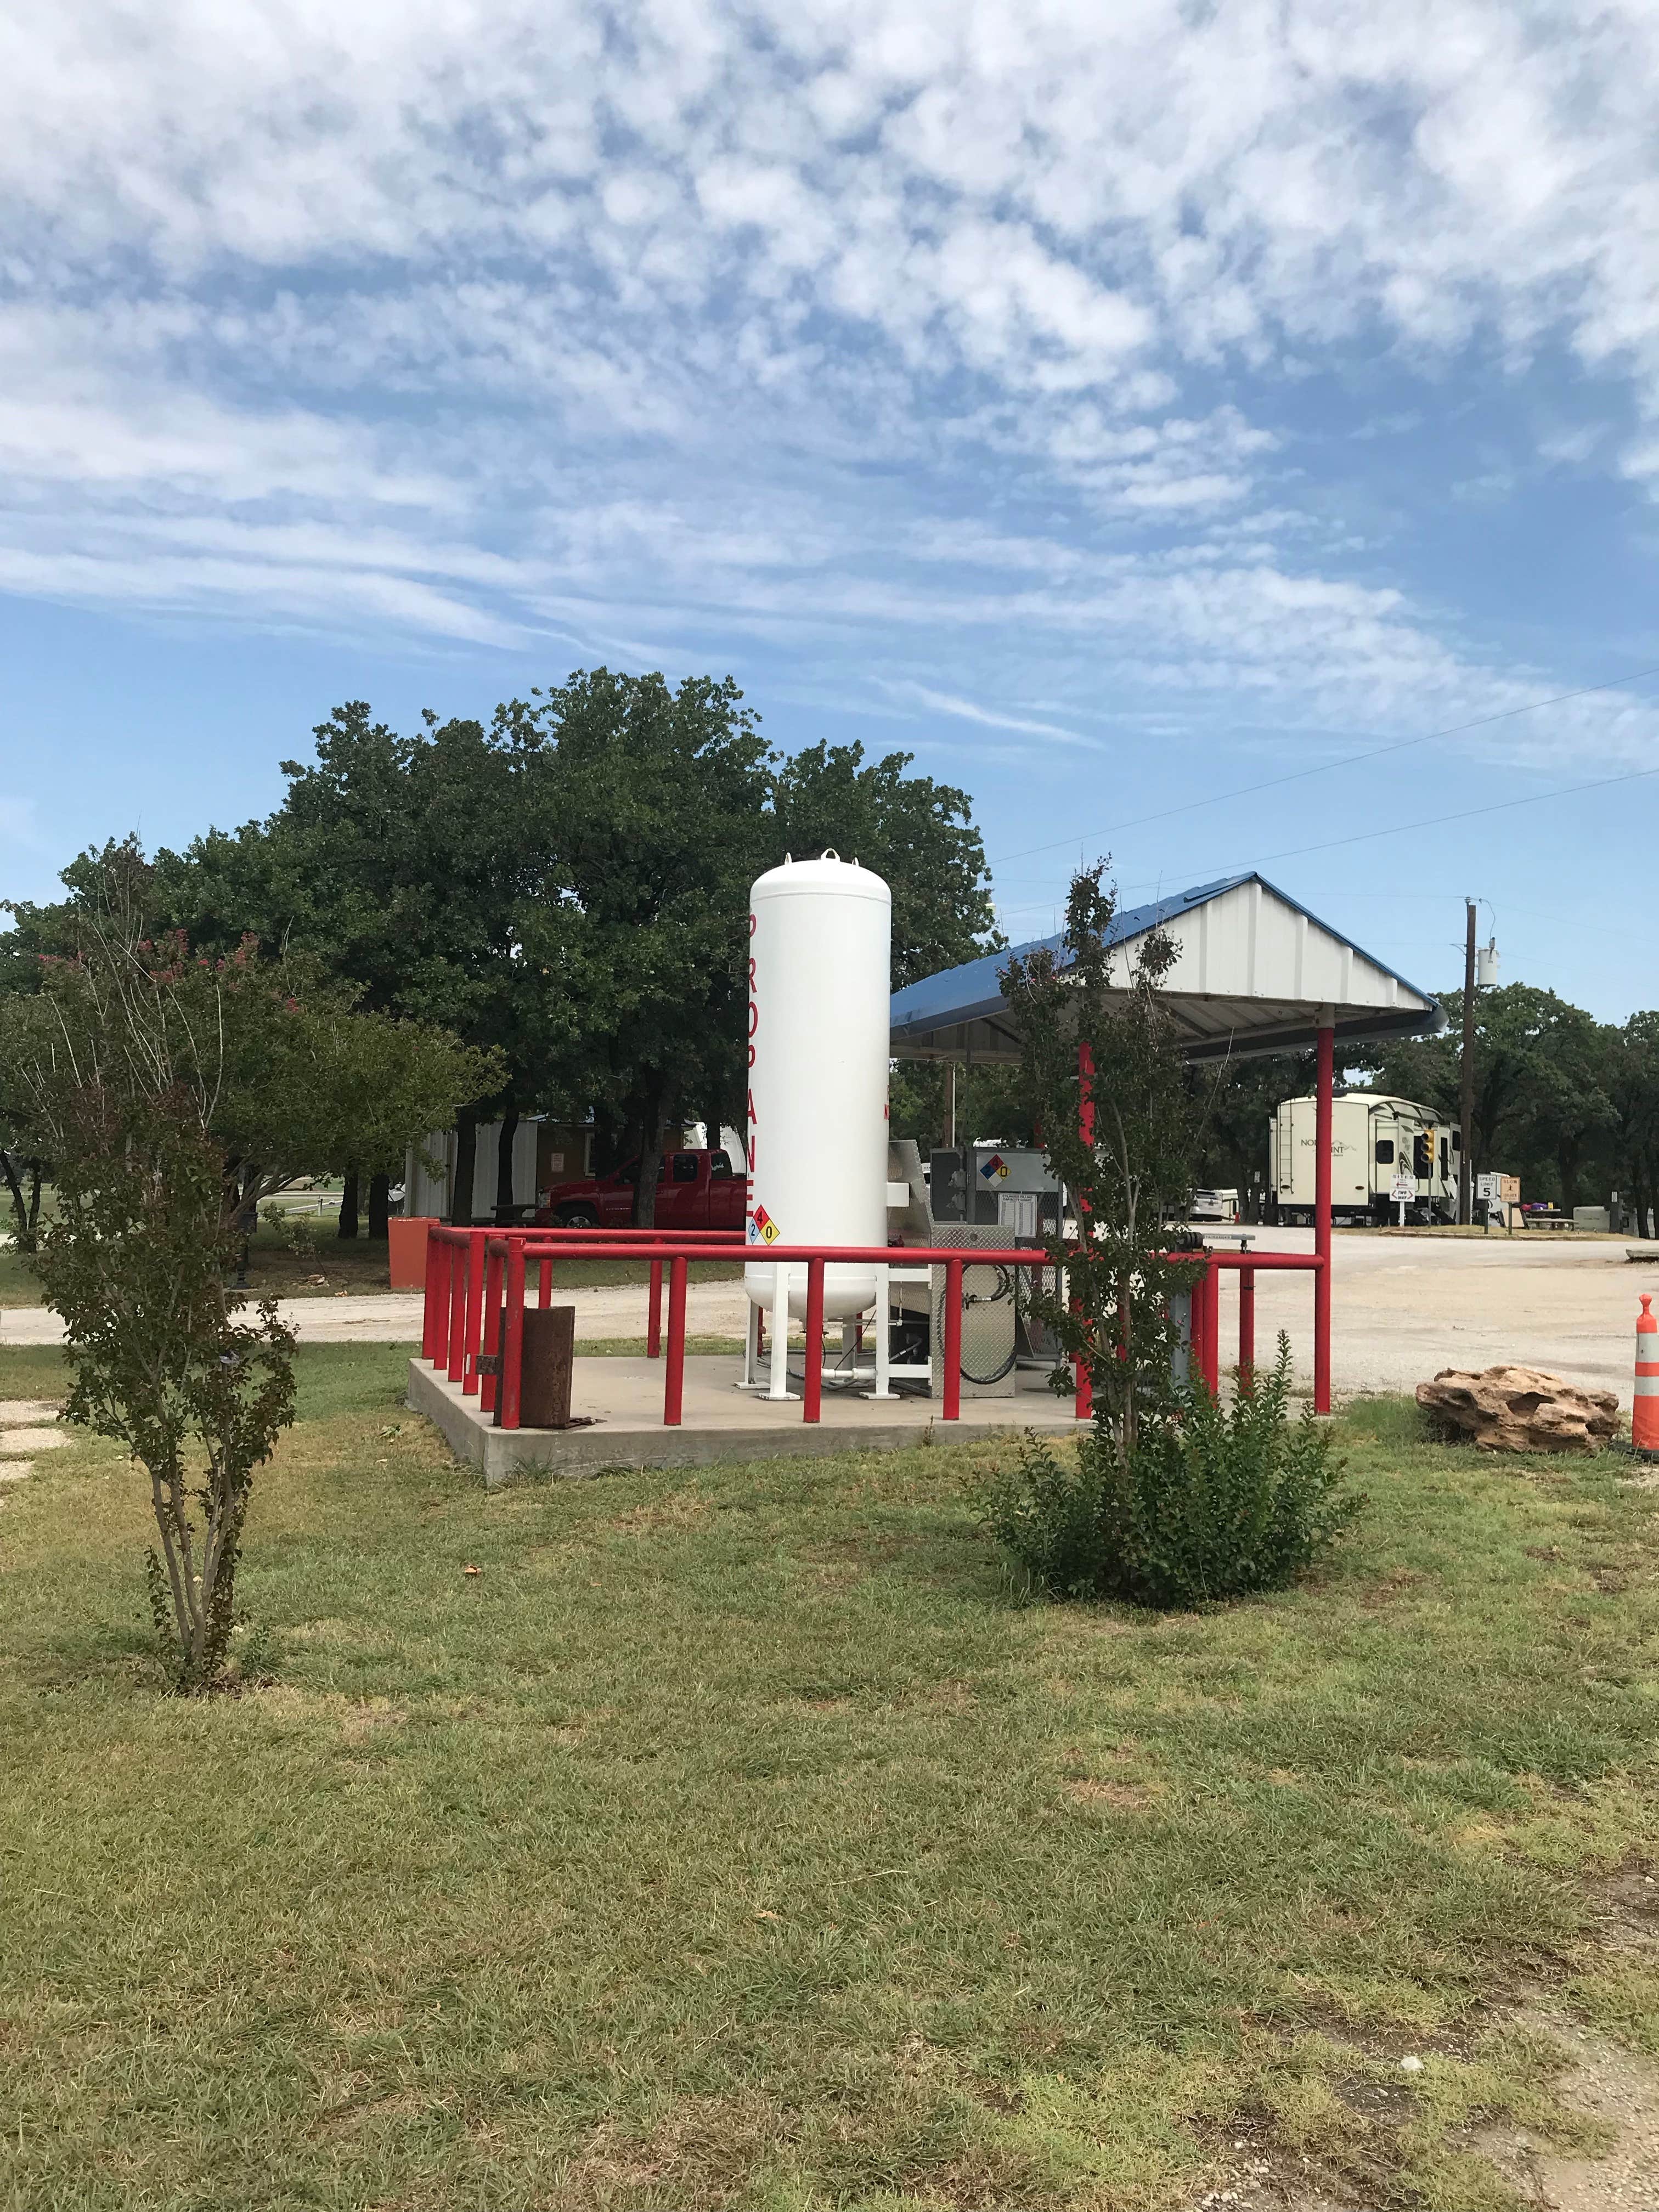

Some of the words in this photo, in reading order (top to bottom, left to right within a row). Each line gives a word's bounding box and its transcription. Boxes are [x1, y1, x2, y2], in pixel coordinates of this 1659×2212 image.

[1000, 1166, 1008, 1177] 0
[1483, 1188, 1491, 1197] 5
[757, 1211, 763, 1224] 4
[751, 1223, 755, 1236] 2
[766, 1226, 772, 1239] 0
